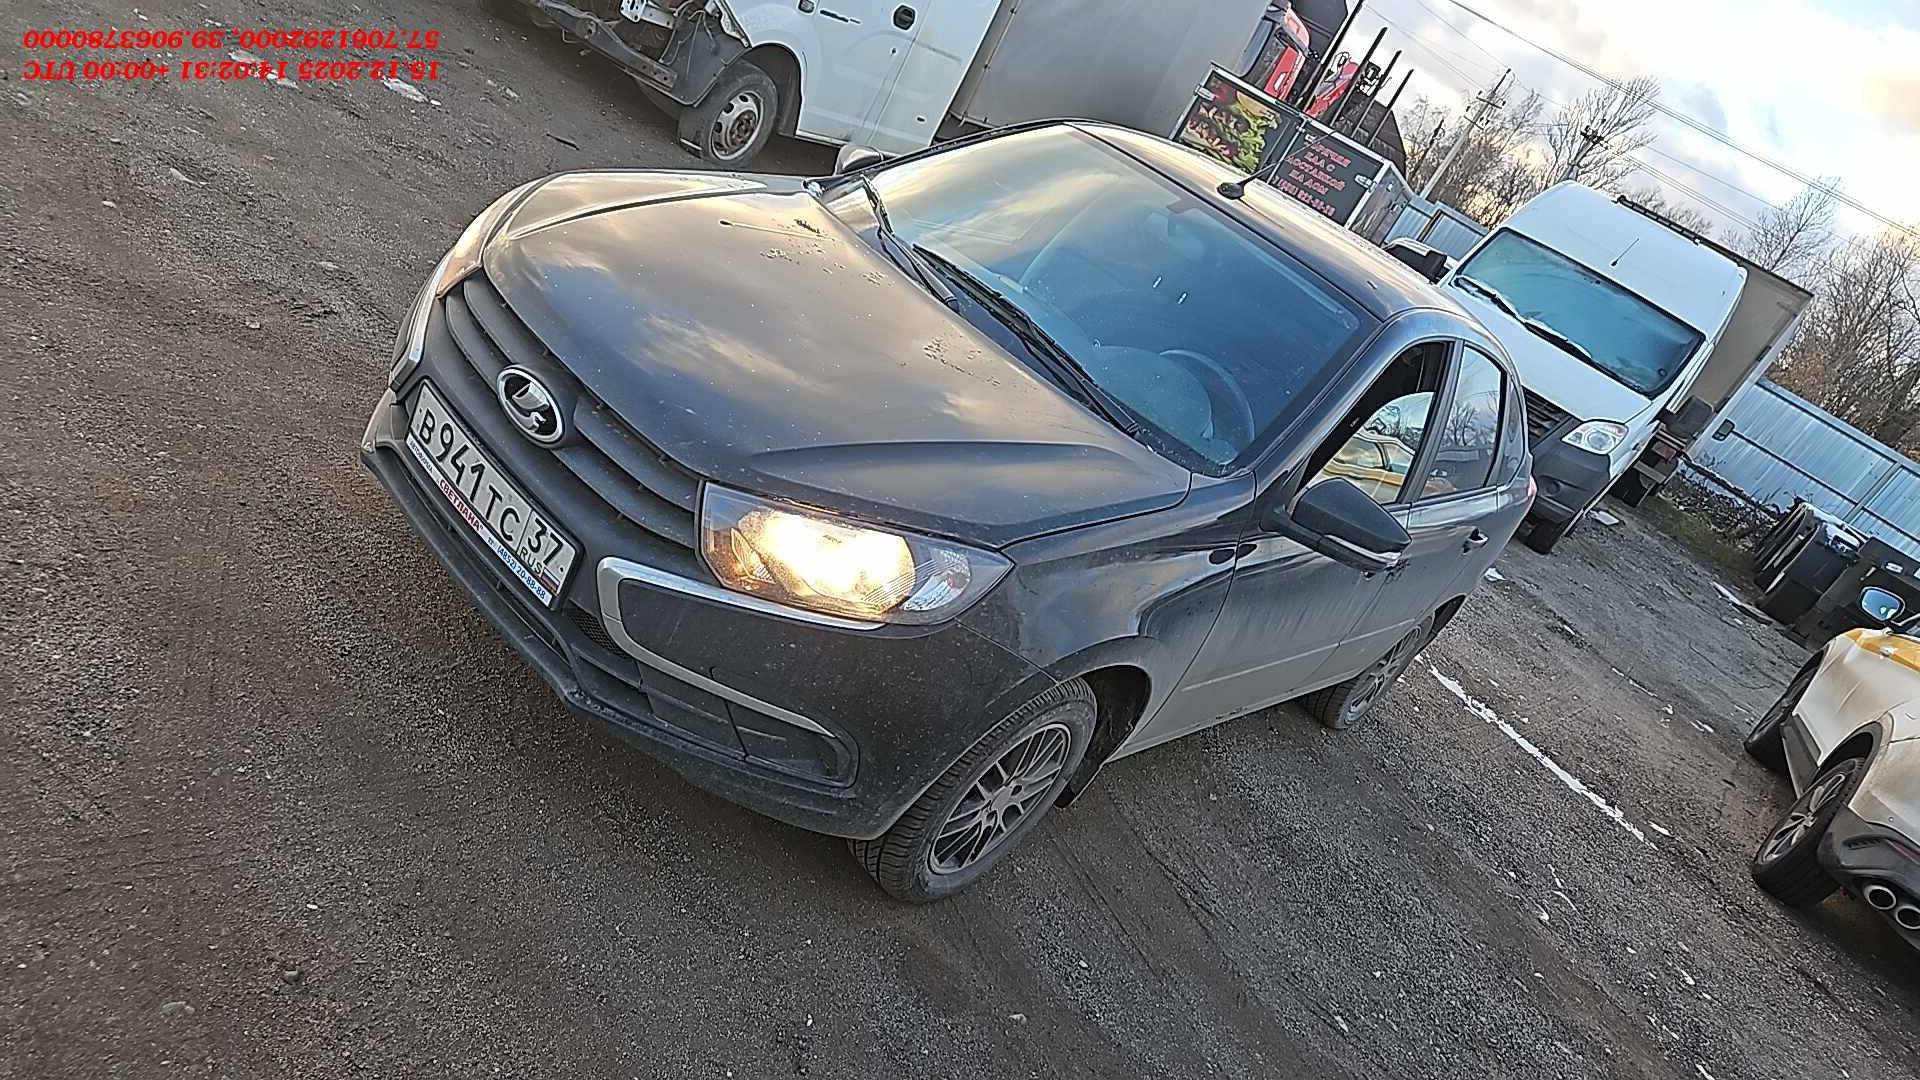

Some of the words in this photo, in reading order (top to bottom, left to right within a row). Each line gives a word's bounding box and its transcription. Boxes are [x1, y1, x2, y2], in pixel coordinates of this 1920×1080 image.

[527, 518, 563, 566] 37
[520, 547, 542, 578] RUS
[516, 567, 546, 600] 20-88-88
